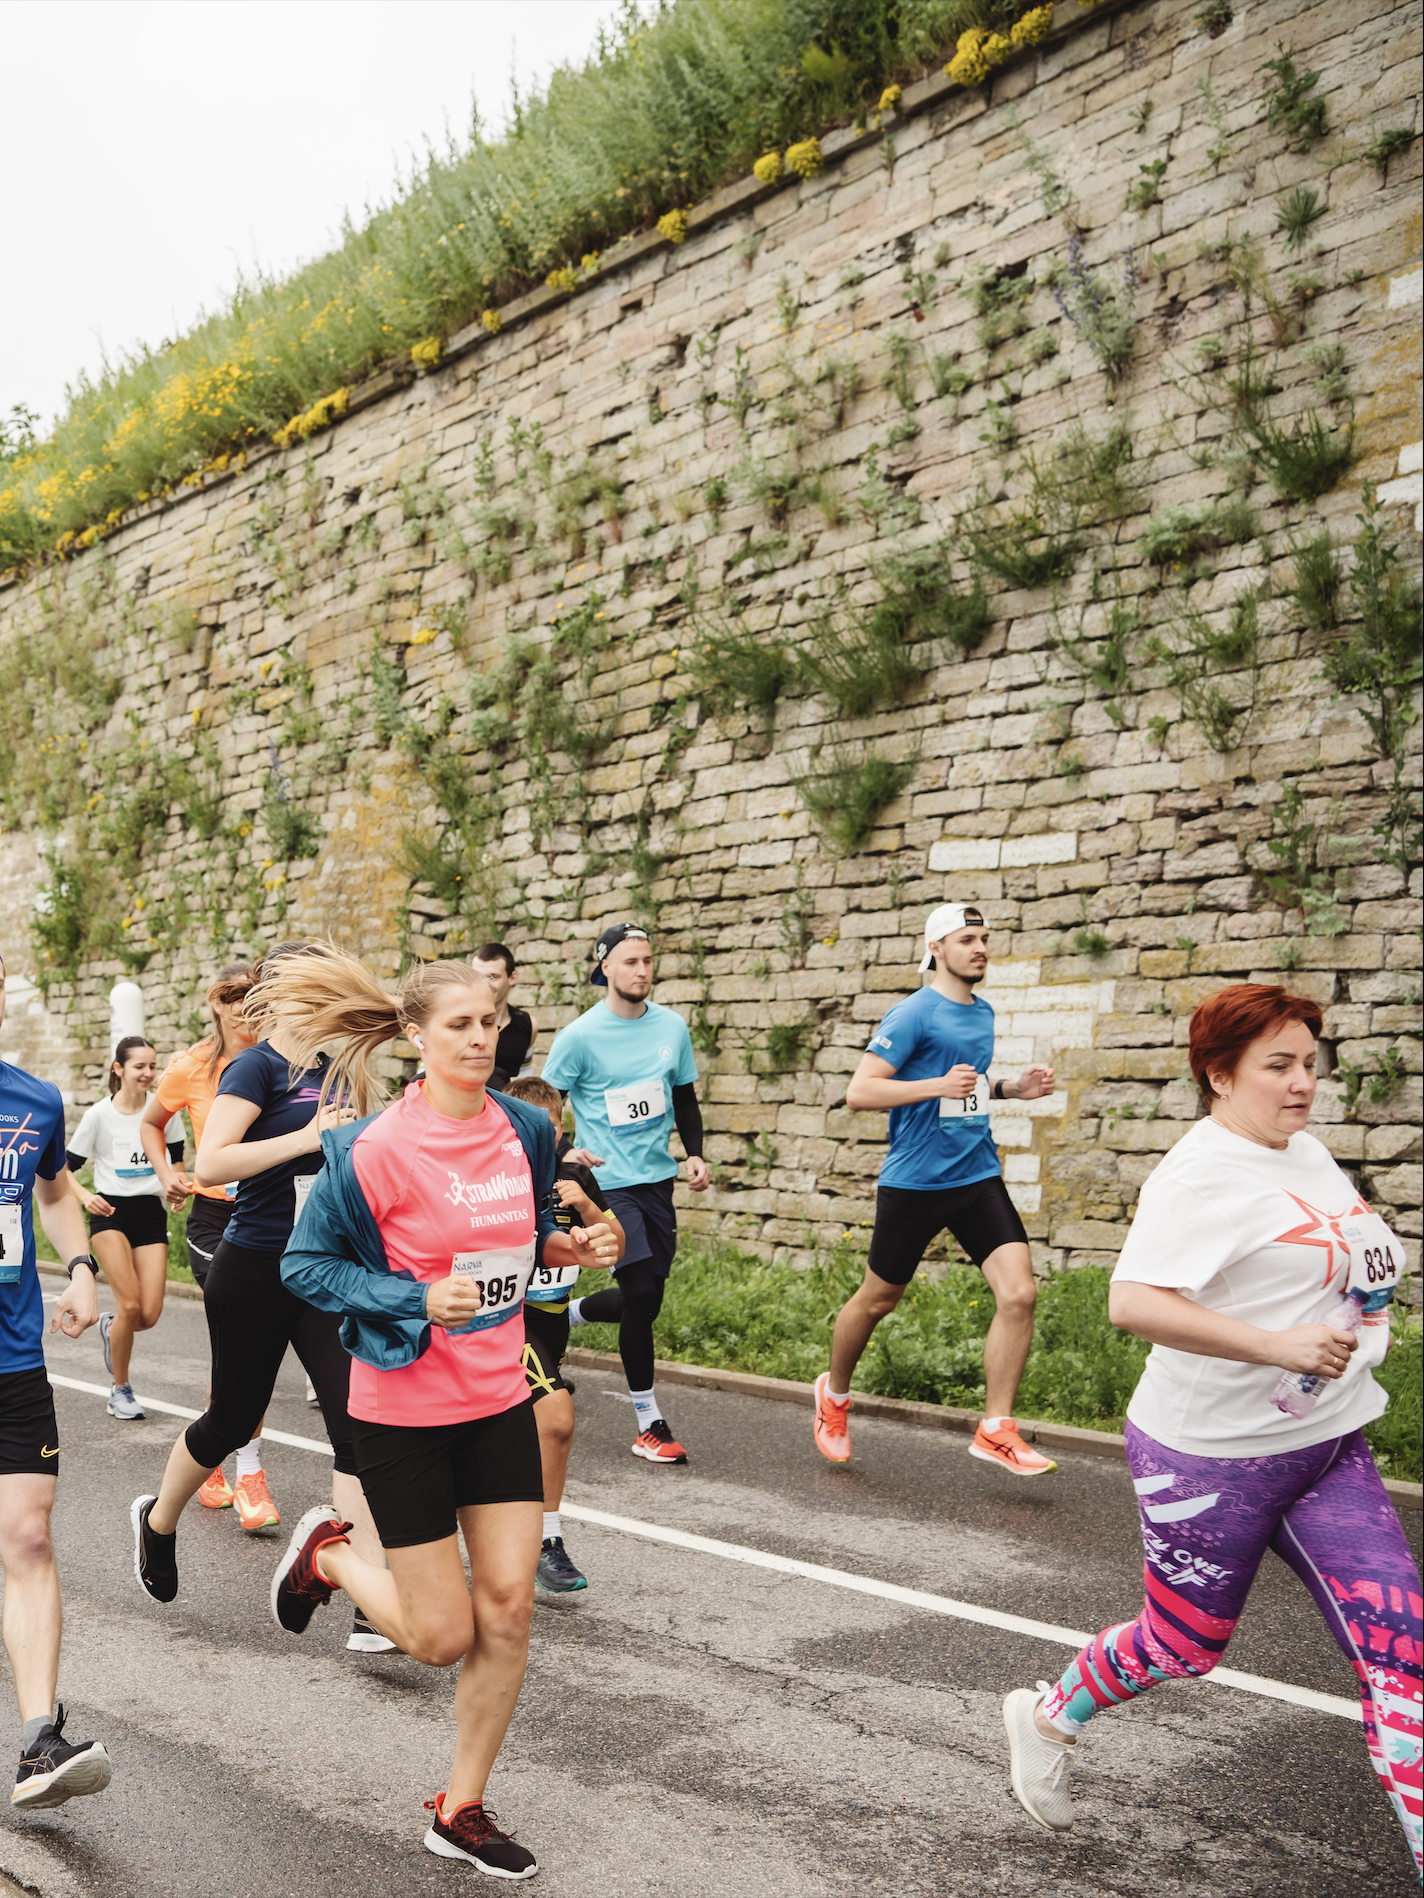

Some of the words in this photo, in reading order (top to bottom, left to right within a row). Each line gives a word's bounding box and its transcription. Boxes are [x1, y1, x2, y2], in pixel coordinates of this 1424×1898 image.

[627, 1100, 649, 1119] 30
[963, 1094, 978, 1112] 13
[469, 1208, 529, 1228] HUMANITAS
[453, 1260, 483, 1272] NARVA
[1364, 1245, 1396, 1284] 834
